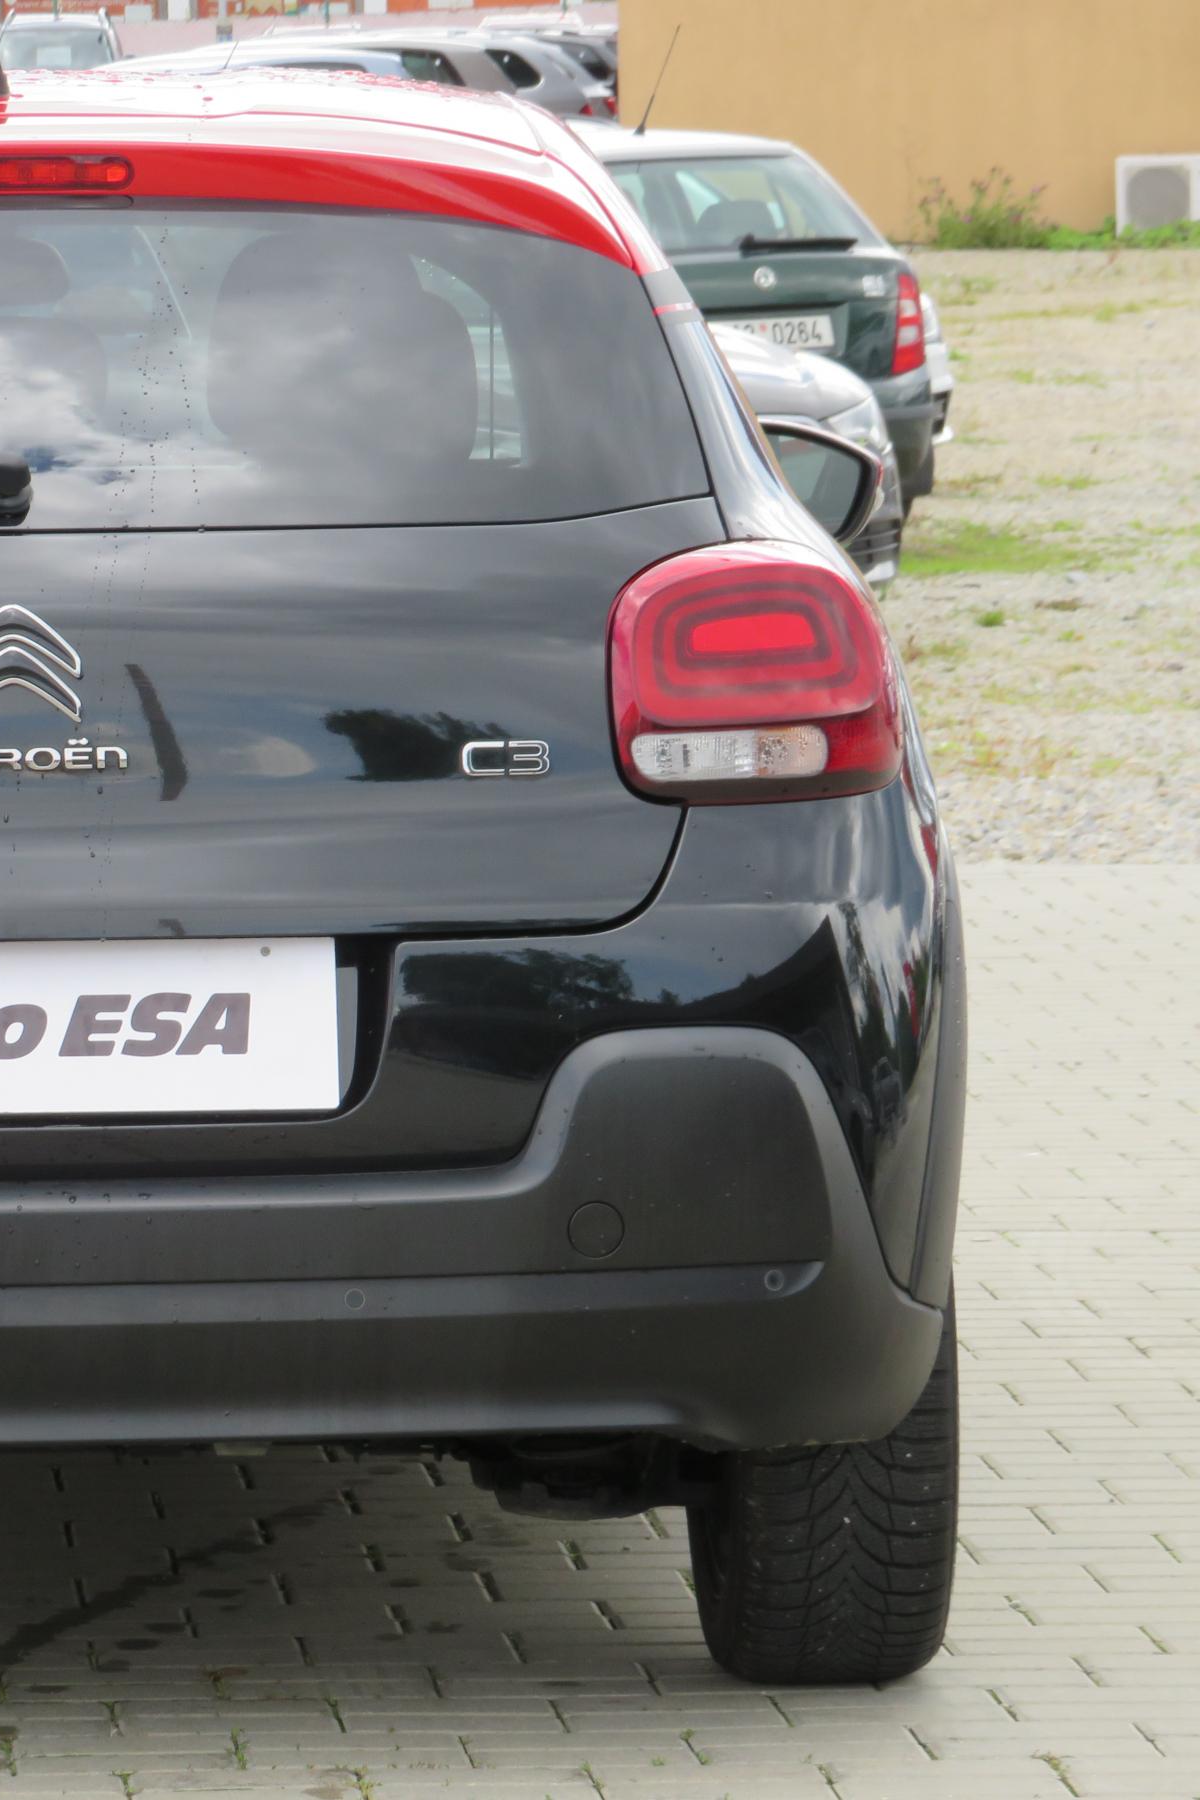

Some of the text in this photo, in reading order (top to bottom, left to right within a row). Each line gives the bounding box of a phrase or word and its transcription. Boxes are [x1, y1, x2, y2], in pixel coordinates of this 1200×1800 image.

[771, 319, 822, 344] 0284
[462, 740, 550, 776] C3
[58, 992, 250, 1057] ESA
